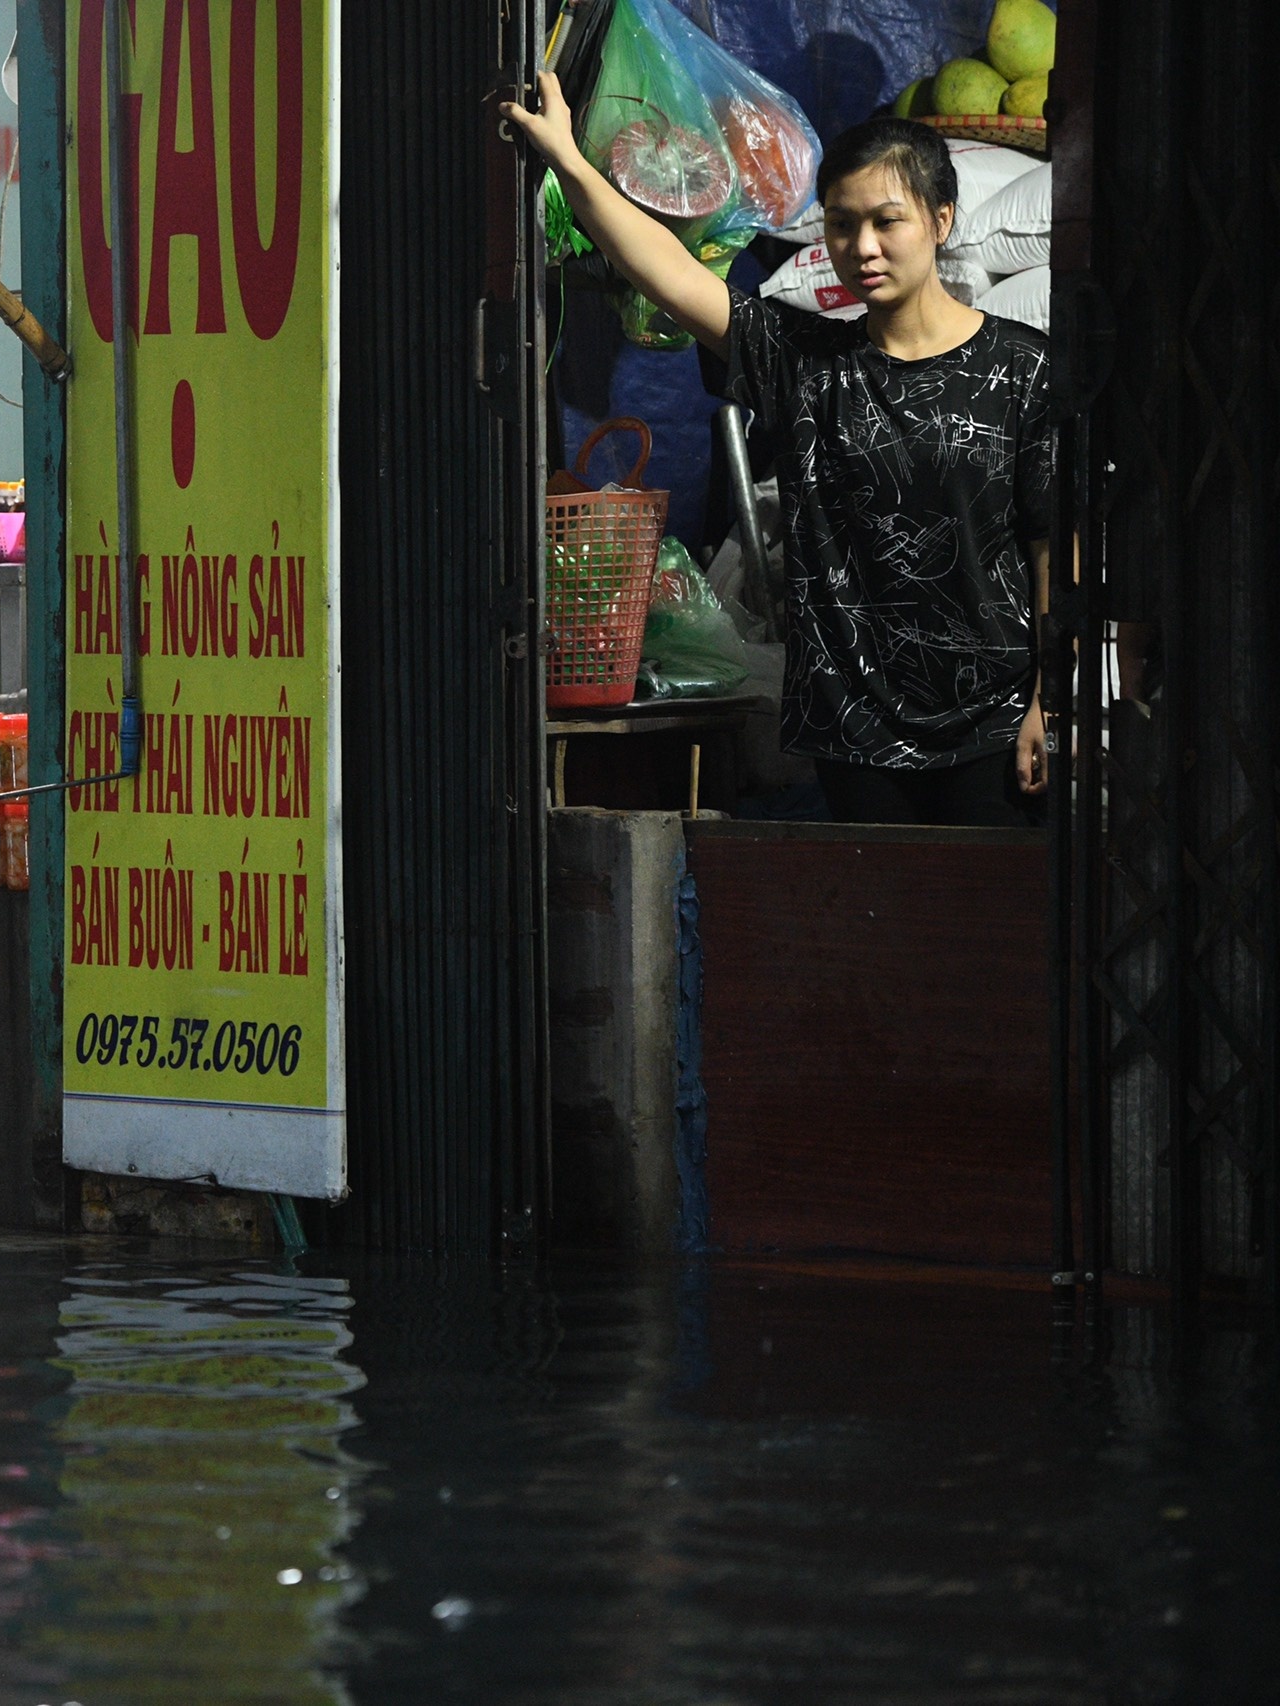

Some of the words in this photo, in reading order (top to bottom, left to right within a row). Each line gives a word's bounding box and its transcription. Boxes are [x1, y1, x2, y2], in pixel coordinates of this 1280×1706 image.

[161, 524, 239, 659] NÔNG
[248, 519, 306, 659] SẢN
[69, 677, 120, 814] CHÈ
[203, 685, 311, 818] NGUYÊN
[70, 831, 120, 966] BÁN
[128, 838, 194, 971] BUÔN
[219, 836, 270, 974] BÁN
[278, 838, 309, 977] LẺ
[75, 1012, 303, 1077] 0975.57.0506
